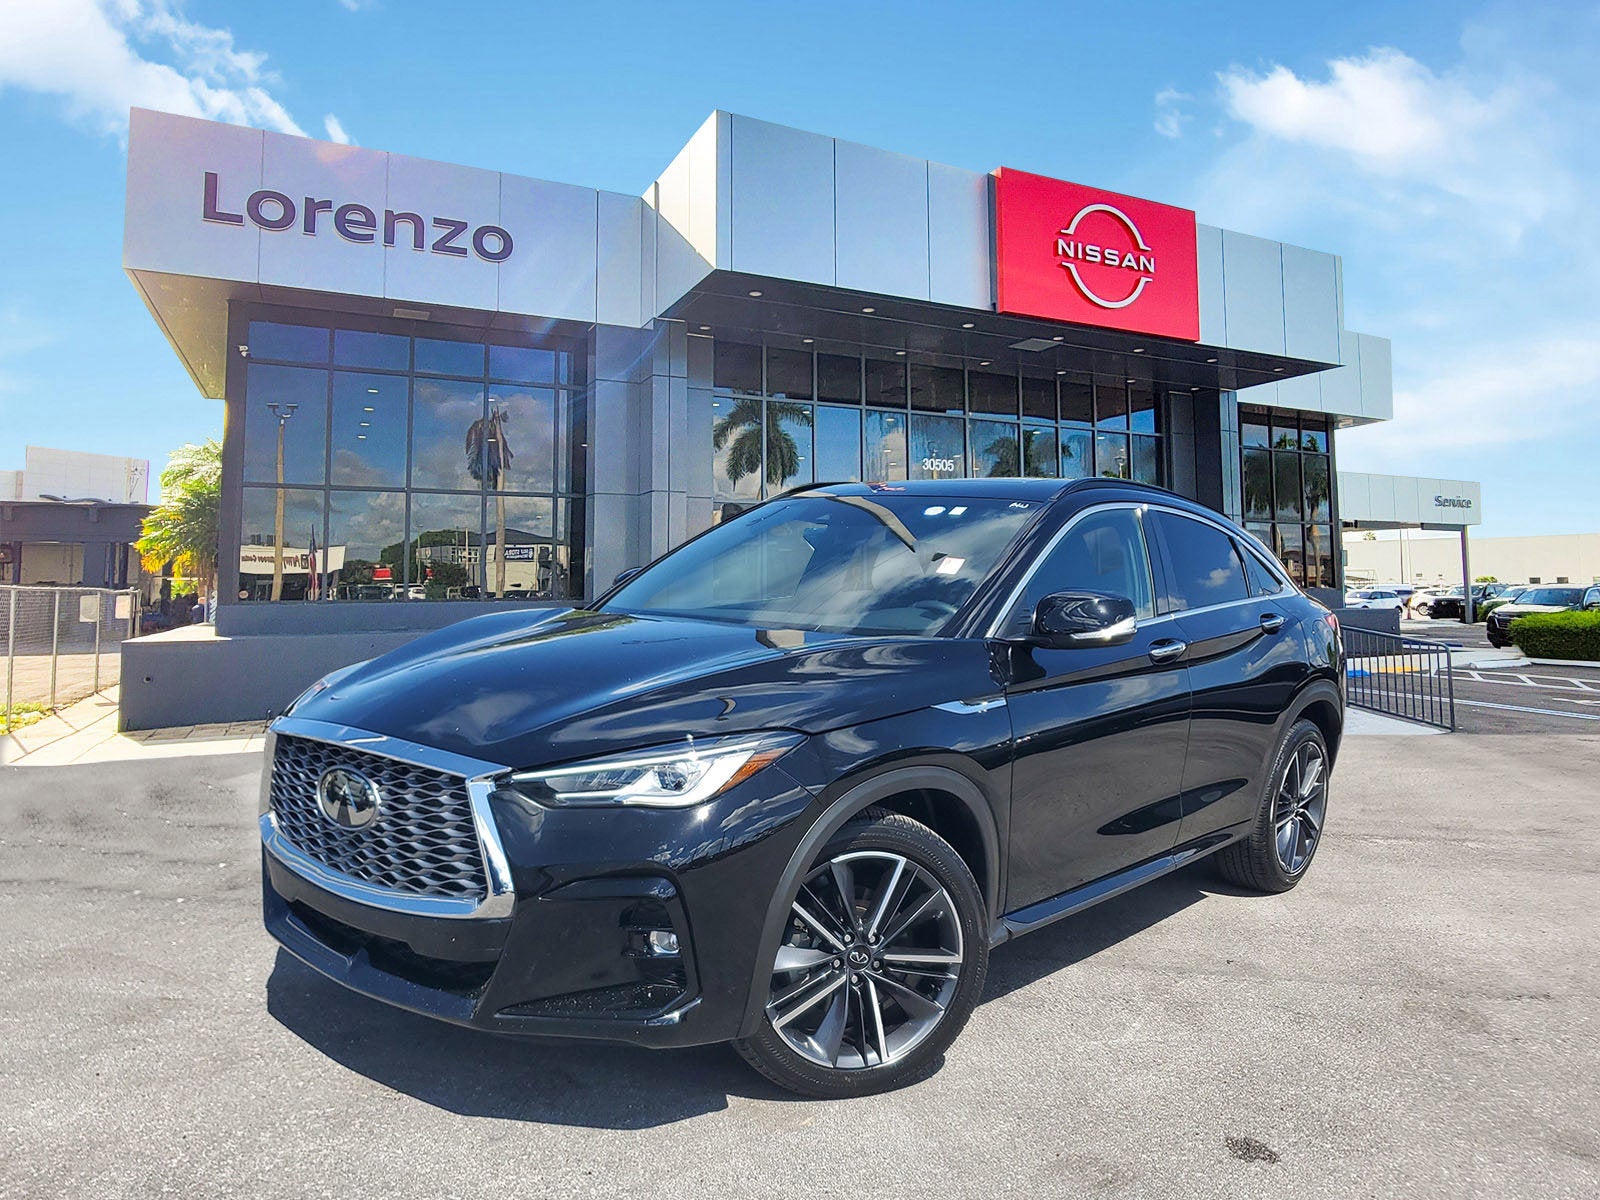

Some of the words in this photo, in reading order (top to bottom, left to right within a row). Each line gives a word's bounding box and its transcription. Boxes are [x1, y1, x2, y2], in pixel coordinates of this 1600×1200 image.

[202, 171, 515, 263] Lorenzo
[1057, 238, 1155, 273] NISSAN
[922, 457, 955, 472] 30505
[1434, 495, 1472, 509] Service
